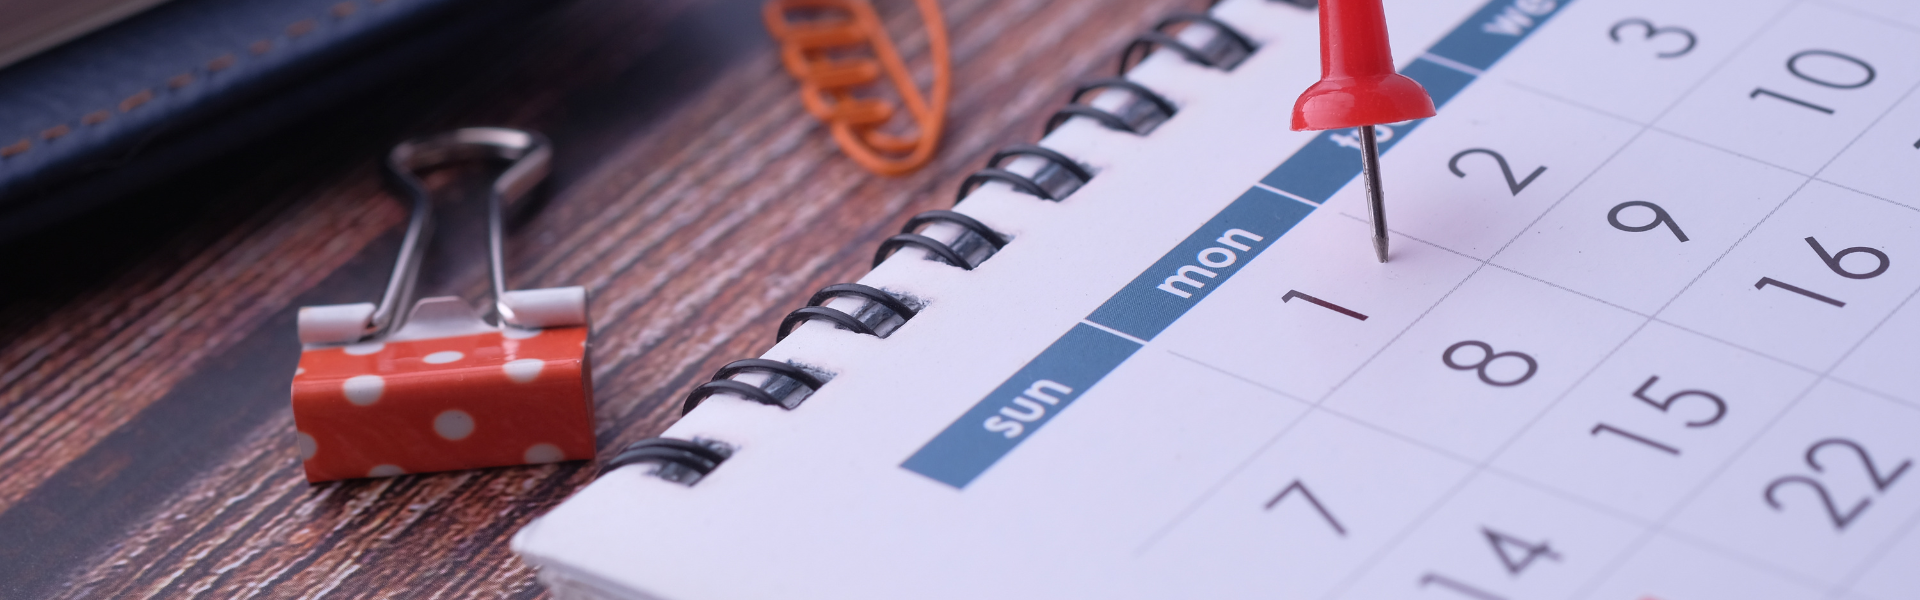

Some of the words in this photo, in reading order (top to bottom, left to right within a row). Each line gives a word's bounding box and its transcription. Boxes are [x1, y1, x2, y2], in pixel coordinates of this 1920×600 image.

[1280, 289, 1370, 322] 1
[1447, 147, 1549, 197] 2
[1607, 17, 1699, 60] 3
[981, 379, 1074, 440] sun
[1156, 228, 1265, 300] mon
[1264, 477, 1349, 537] 7
[1441, 339, 1540, 388] 8
[1606, 200, 1690, 243] 9
[1748, 48, 1878, 116] 10
[1589, 374, 1729, 457] 15
[1753, 236, 1891, 309] 16
[1761, 436, 1914, 532] 22
